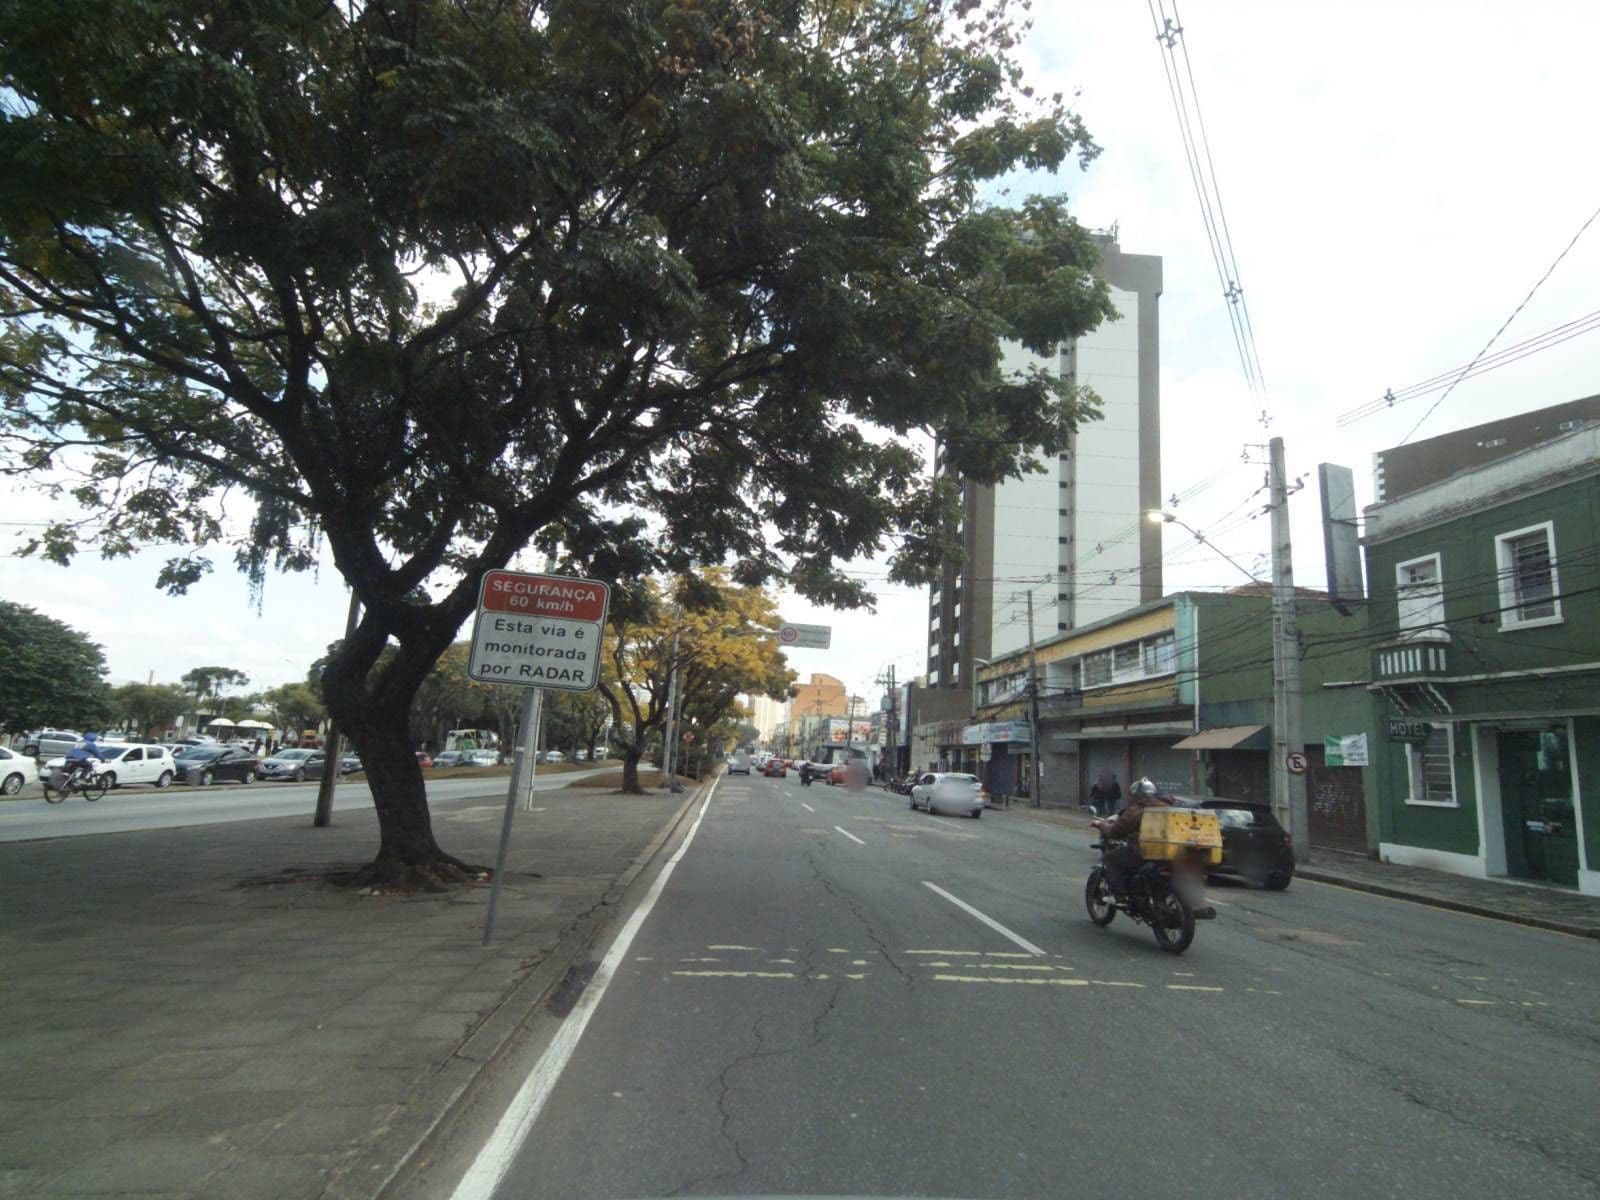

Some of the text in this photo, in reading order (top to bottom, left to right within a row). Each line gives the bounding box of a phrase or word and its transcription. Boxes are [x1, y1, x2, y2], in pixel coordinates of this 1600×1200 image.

[492, 580, 596, 603] SEGURANÇA
[509, 595, 575, 612] 60 km/h
[494, 618, 585, 639] Esta via é
[484, 641, 587, 661] monitorada
[480, 663, 586, 682] por RADAR
[1390, 720, 1426, 737] HOTEL
